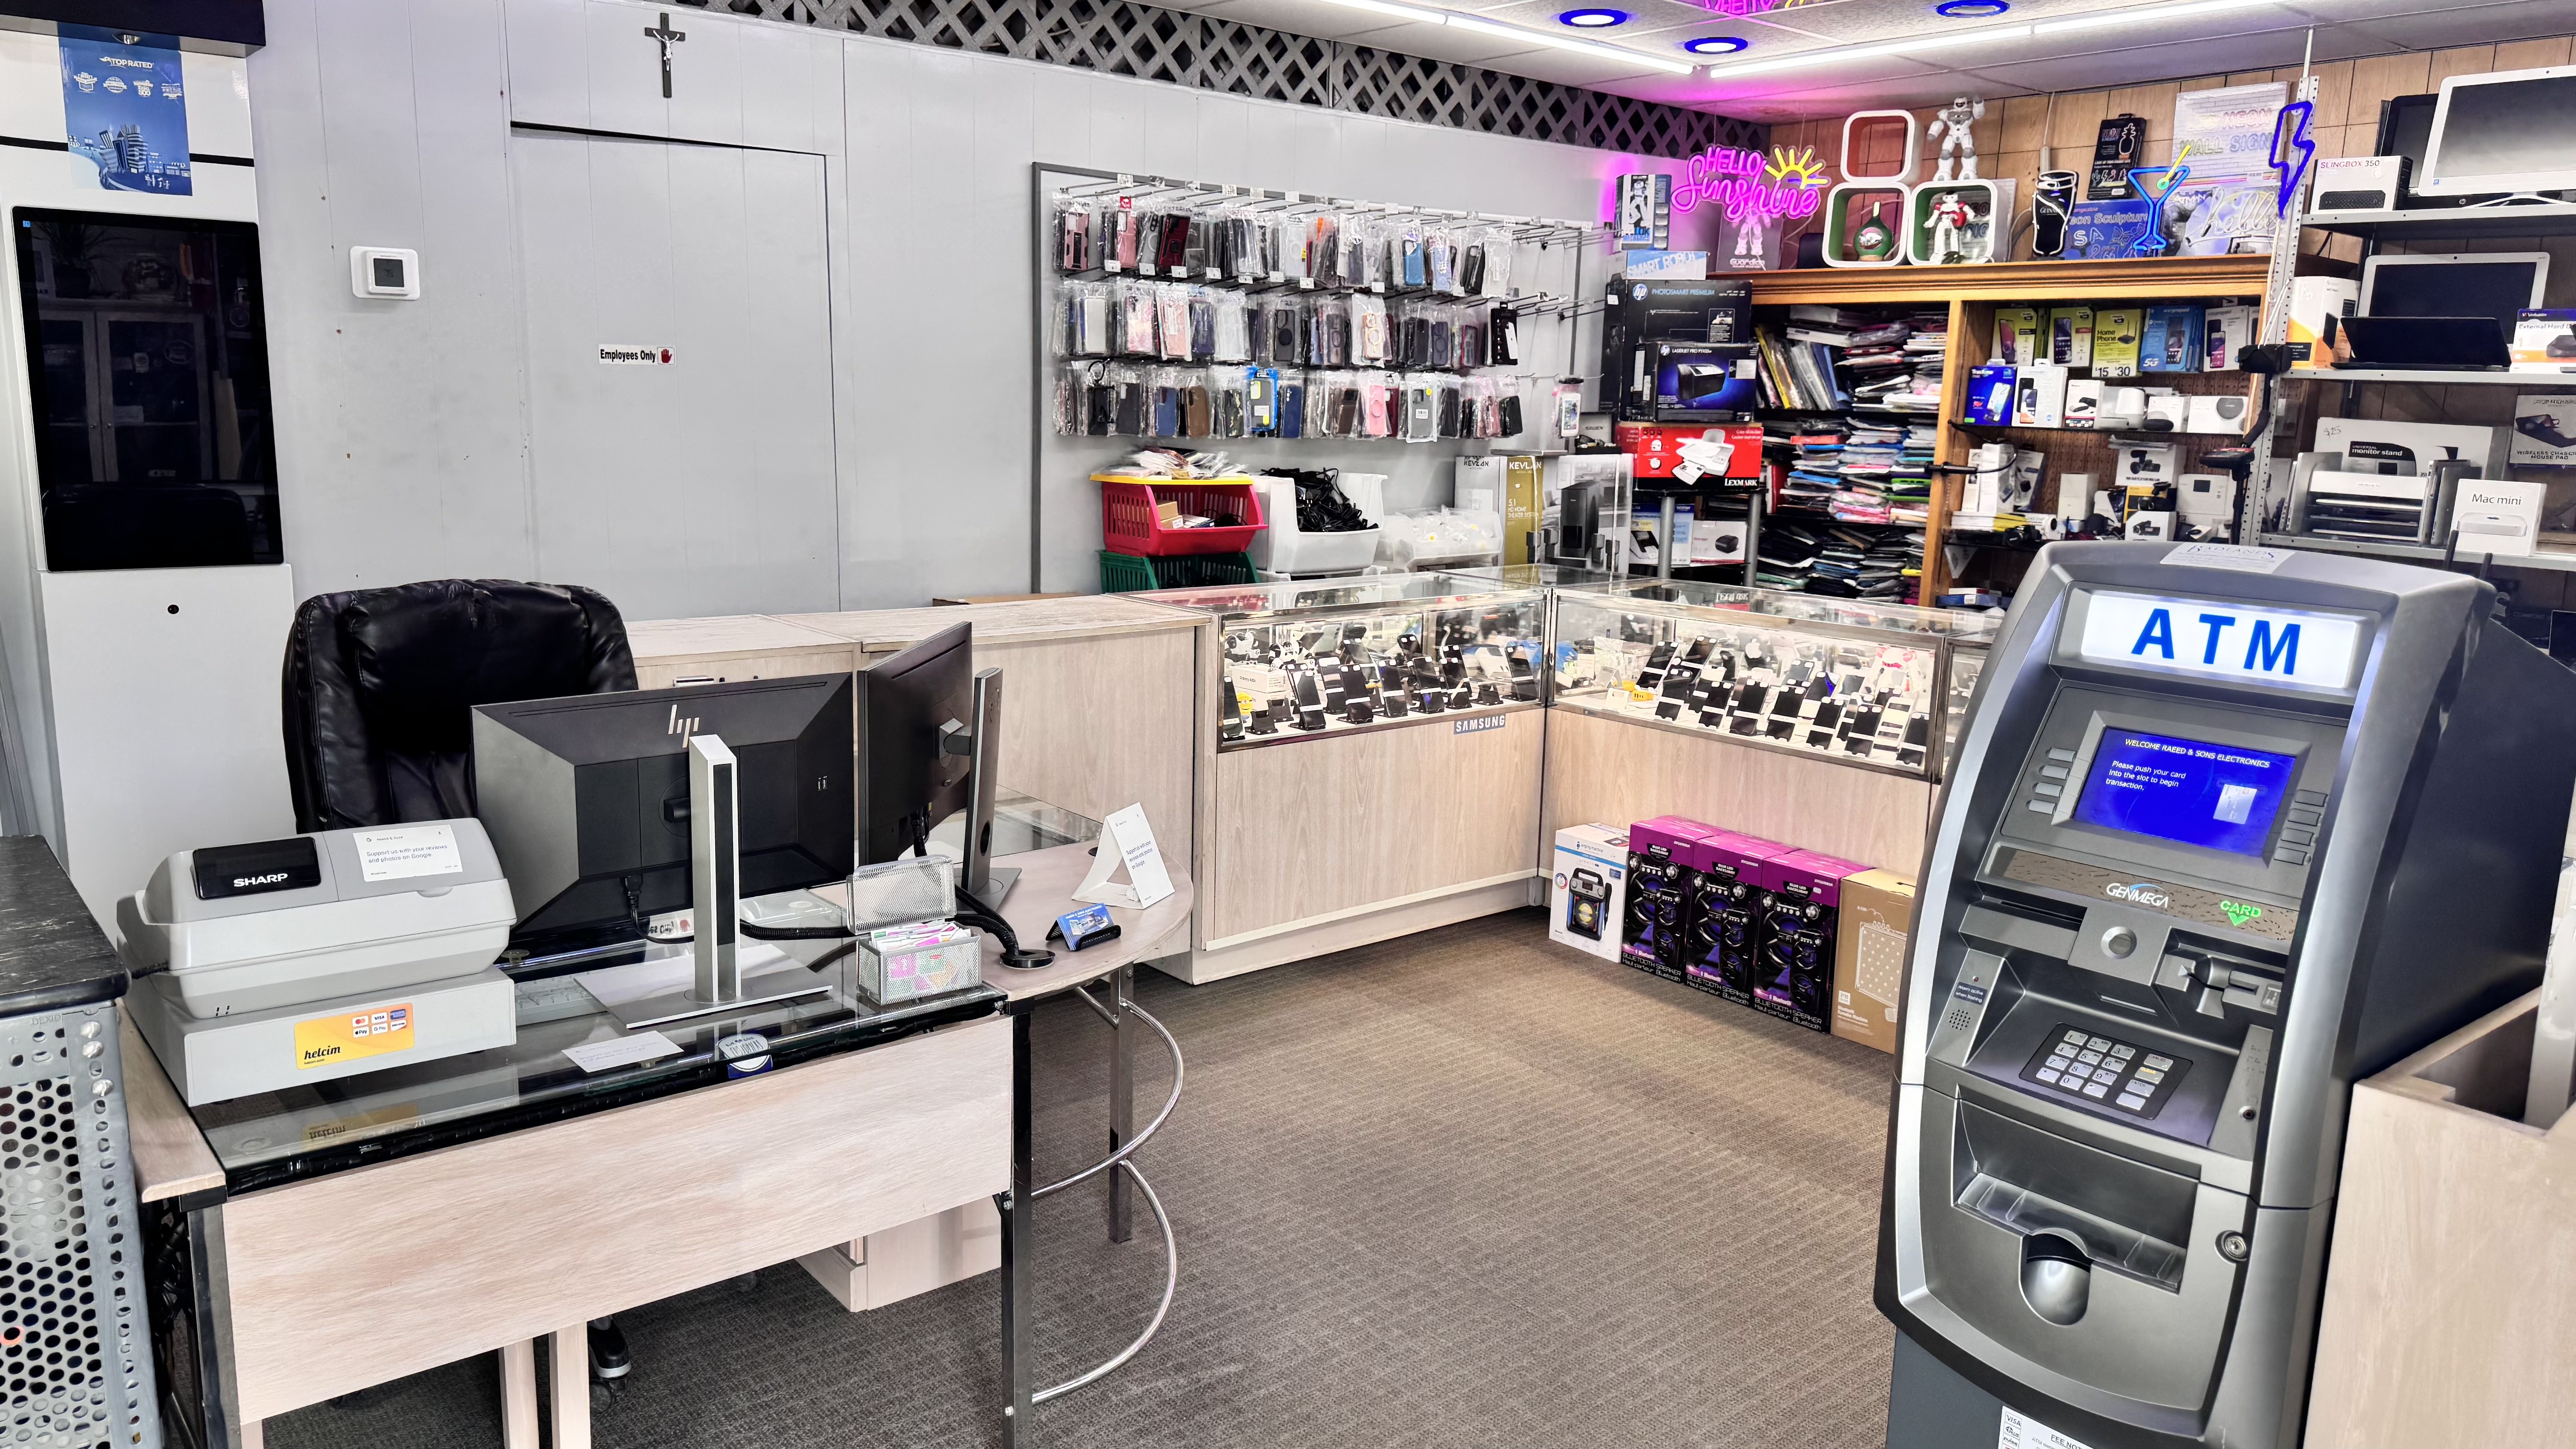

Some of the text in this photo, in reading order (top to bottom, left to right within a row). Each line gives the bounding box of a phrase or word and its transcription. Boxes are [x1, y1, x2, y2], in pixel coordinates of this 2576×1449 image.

[1705, 147, 1763, 176] HELLO
[1671, 155, 1818, 219] Sunshine
[2069, 216, 2092, 225] eon
[600, 349, 656, 363] Employees Only
[2143, 358, 2159, 367] 5G
[1724, 478, 1757, 487] LEXMARK
[2472, 494, 2522, 505] Mac mini
[2131, 607, 2301, 675] ATM
[1456, 715, 1505, 732] SAMSUNG
[2125, 738, 2161, 750] WELCOME
[2162, 744, 2186, 754] RAEED
[2194, 750, 2216, 759] SONS
[2217, 754, 2270, 768] ELECTRONICS
[2112, 760, 2186, 779] Please push your card
[2106, 778, 2145, 791] transaction.
[2124, 771, 2135, 779] the
[2136, 773, 2149, 782] slot
[2159, 777, 2179, 787] begin
[234, 873, 288, 887] SHARP
[1786, 886, 1809, 895] BACKLIGHT
[2106, 883, 2169, 909] GENMEGA
[2219, 900, 2262, 918] CARD
[1623, 952, 1681, 976] BLUETOOTH SPEAKER
[1623, 957, 1681, 982] Haut-parleur Bluetooth
[1687, 974, 1750, 999] BLUETOOTH SPEAKER
[1687, 980, 1749, 1006] Haut-parleur Bluetooth
[1967, 994, 1983, 1003] flashing
[1754, 1003, 1822, 1030] Haut-parleur Bluetooth
[1755, 997, 1792, 1015] BLUETOOTH
[1793, 1010, 1822, 1025] SPEAKER
[304, 1045, 341, 1060] helcim
[2006, 1415, 2021, 1426] VISA
[2051, 1434, 2065, 1446] FEE
